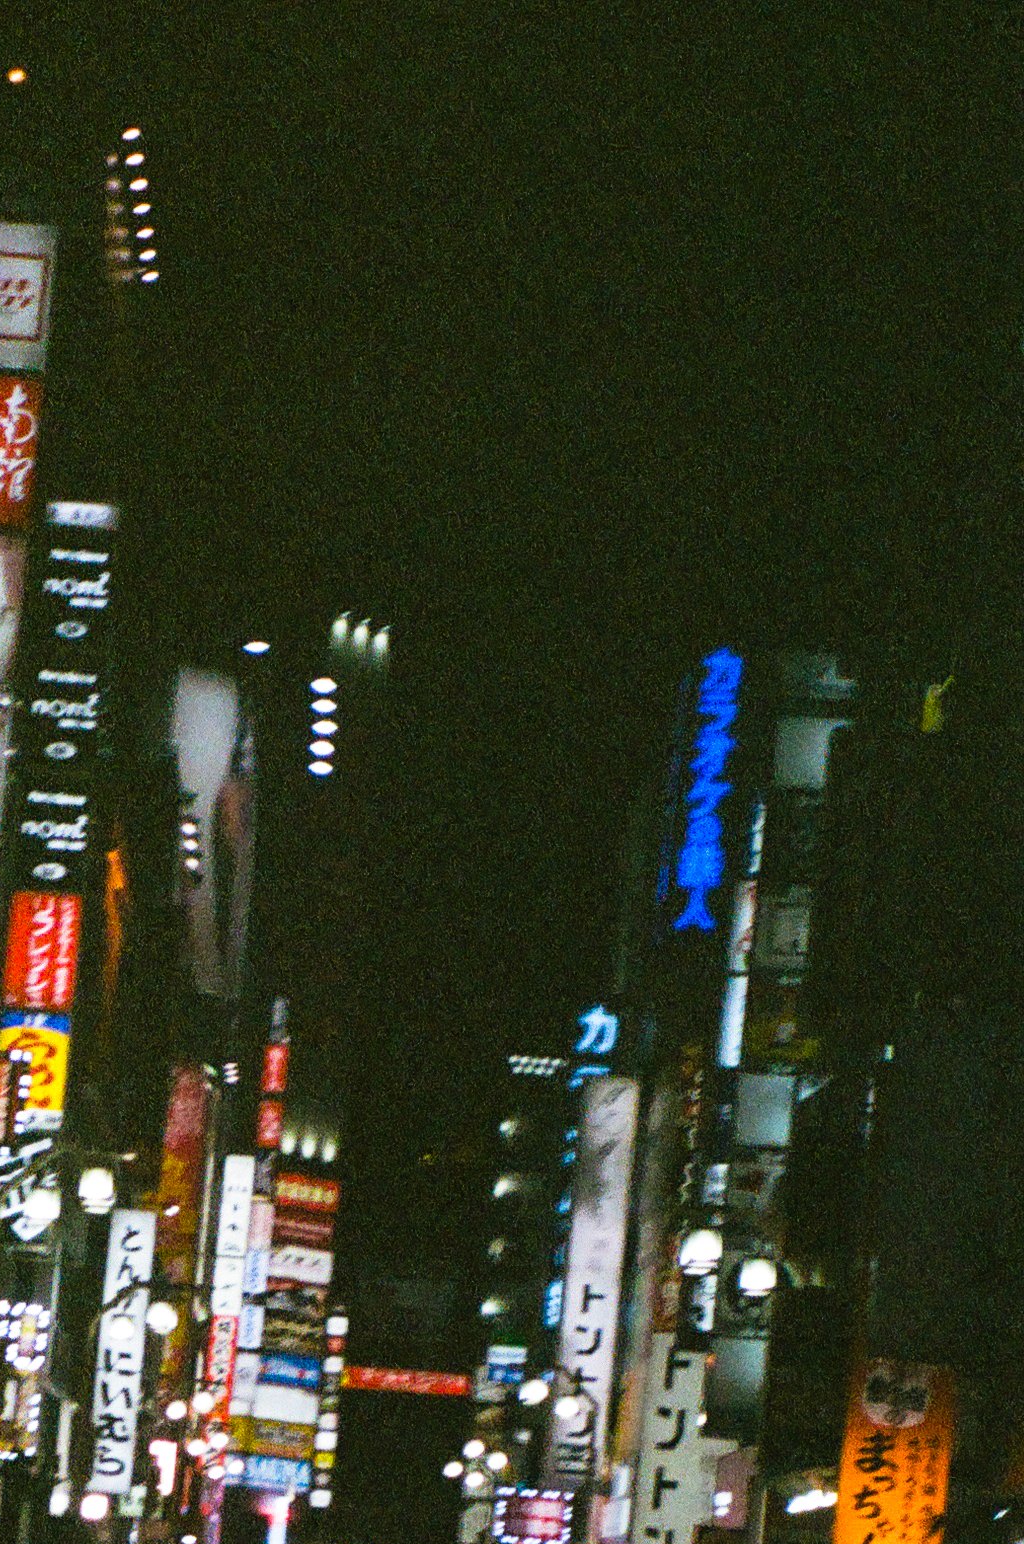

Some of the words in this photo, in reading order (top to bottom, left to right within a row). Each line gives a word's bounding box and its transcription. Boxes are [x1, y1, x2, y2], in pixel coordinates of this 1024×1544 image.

[94, 1224, 144, 1477] とんにいむら
